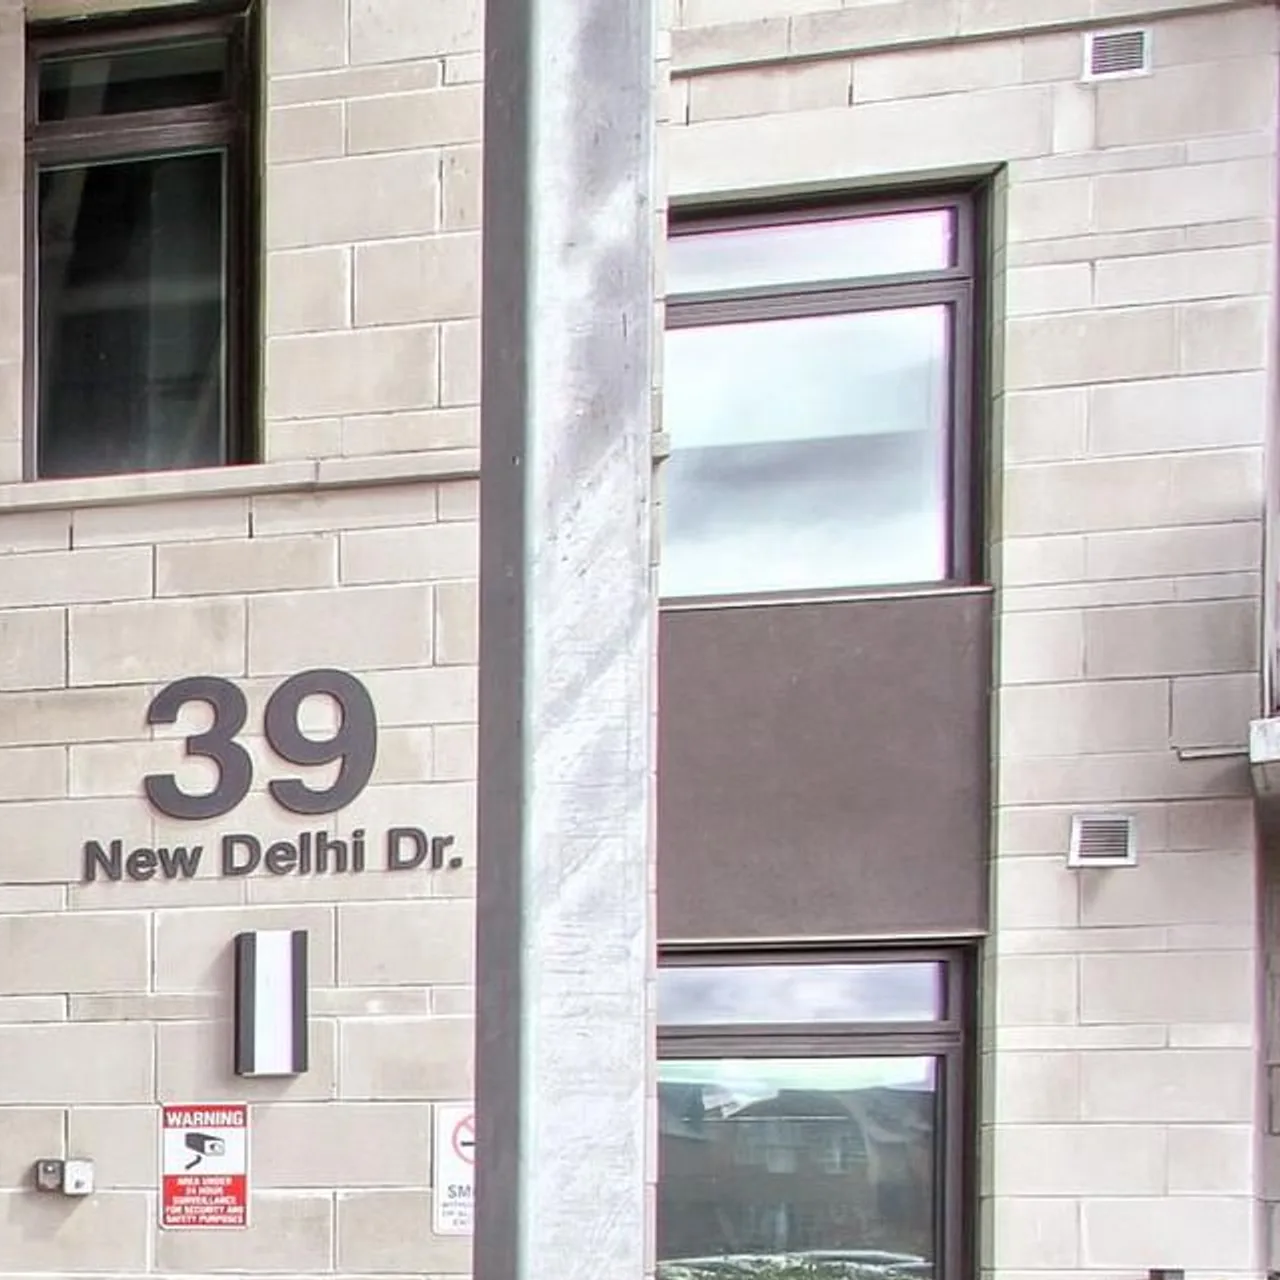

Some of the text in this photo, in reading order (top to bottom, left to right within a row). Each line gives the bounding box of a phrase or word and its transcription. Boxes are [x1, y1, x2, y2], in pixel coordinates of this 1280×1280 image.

[144, 668, 377, 820] 39
[83, 827, 462, 882] New Delhi Dr.
[166, 1110, 244, 1126] WARNING
